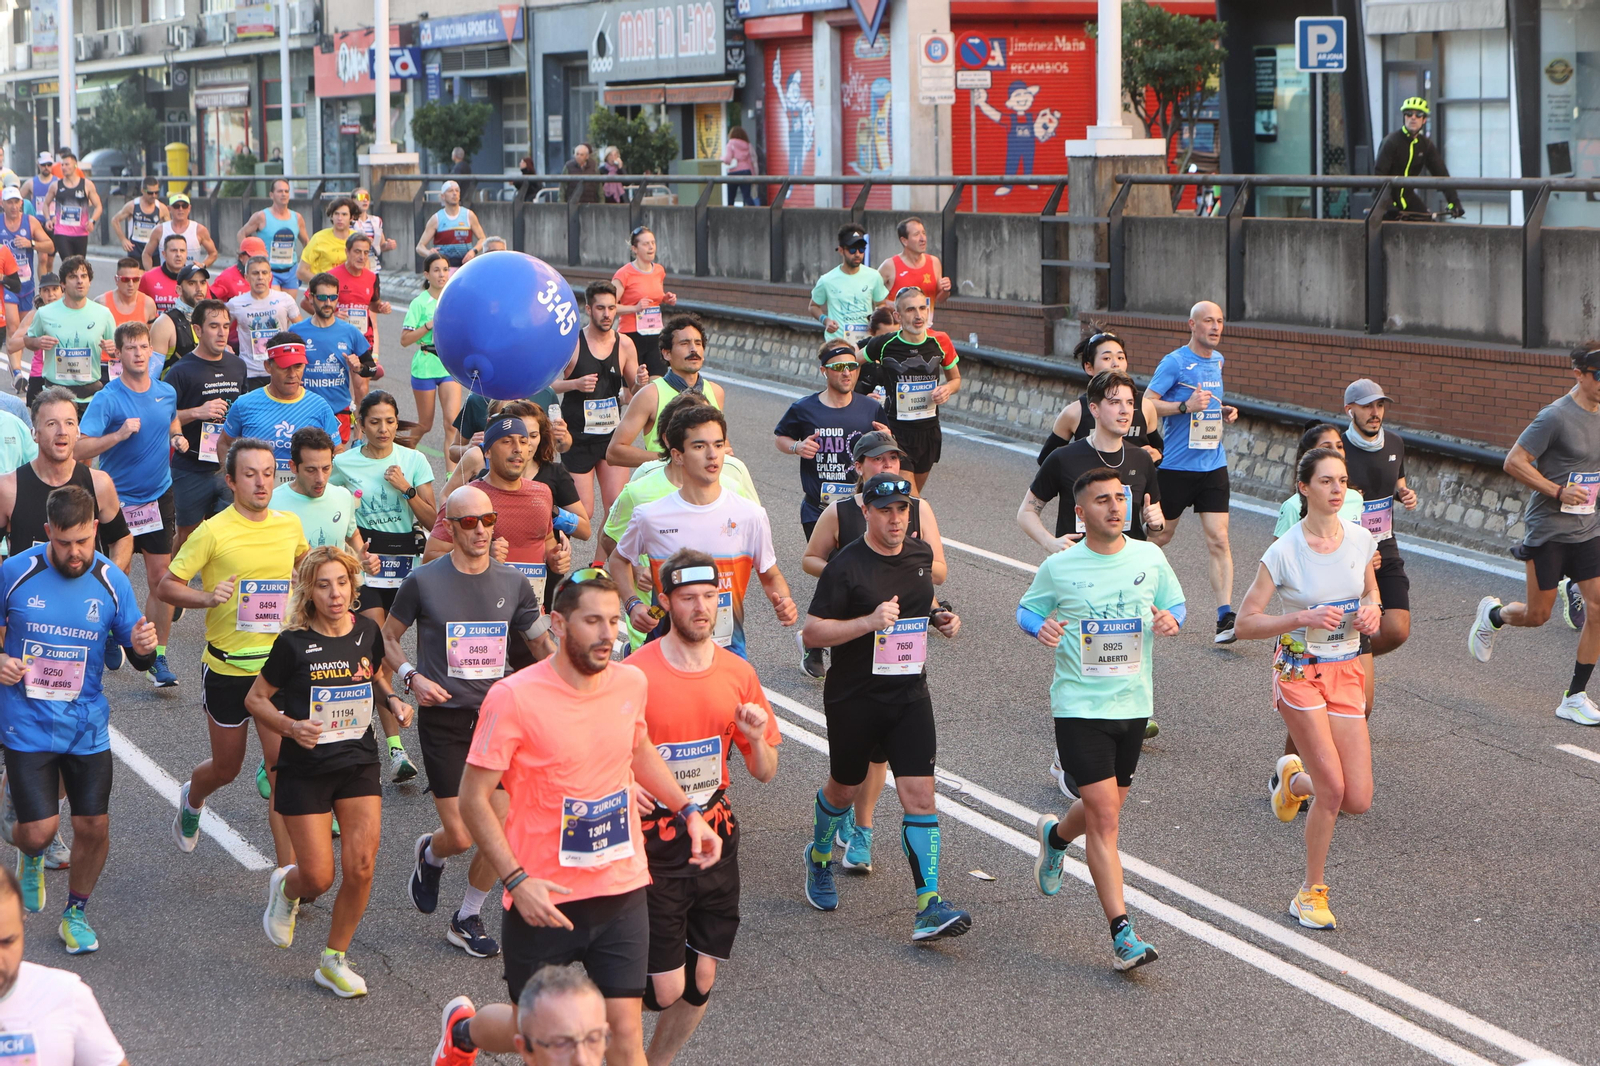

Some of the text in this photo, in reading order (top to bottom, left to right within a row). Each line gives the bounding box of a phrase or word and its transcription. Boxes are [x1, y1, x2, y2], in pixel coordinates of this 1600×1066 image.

[434, 22, 467, 40] AUTOCLIMA
[1008, 35, 1086, 56] Jiménez Maña
[1307, 25, 1337, 67] P
[1318, 52, 1343, 60] ARJONA
[1010, 62, 1069, 74] RECAMBIOS
[537, 280, 577, 336] 3:45
[247, 310, 277, 319] MADRID
[304, 378, 346, 388] FINISHER
[815, 437, 844, 453] DAD
[816, 453, 837, 463] OF AN
[817, 463, 845, 472] EPILEPSY
[818, 472, 846, 480] WARRIOR
[1368, 500, 1390, 511] ZURICH
[1368, 517, 1382, 525] 7590
[26, 622, 99, 641] TROTASIERRA
[896, 622, 924, 632] ZURICH
[1103, 622, 1135, 632] ZURICH
[1327, 633, 1344, 641] ABBIE
[469, 646, 488, 654] 8498
[896, 641, 913, 650] 7650
[1103, 642, 1123, 651] 8925
[46, 649, 79, 659] ZURICH
[310, 660, 350, 672] MARATÓN
[43, 668, 63, 677] 8250
[310, 668, 352, 681] SEVILLA
[32, 678, 72, 688] JUAN JESÚS
[334, 688, 366, 699] ZURICH
[332, 708, 354, 718] 11194
[331, 718, 358, 729] RITA
[675, 744, 713, 758] ZURICH
[674, 768, 701, 780] 10482
[693, 778, 719, 791] AMIGOS
[592, 795, 622, 815] ZURICH
[588, 821, 612, 838] 13014
[926, 828, 940, 875] Kalenji
